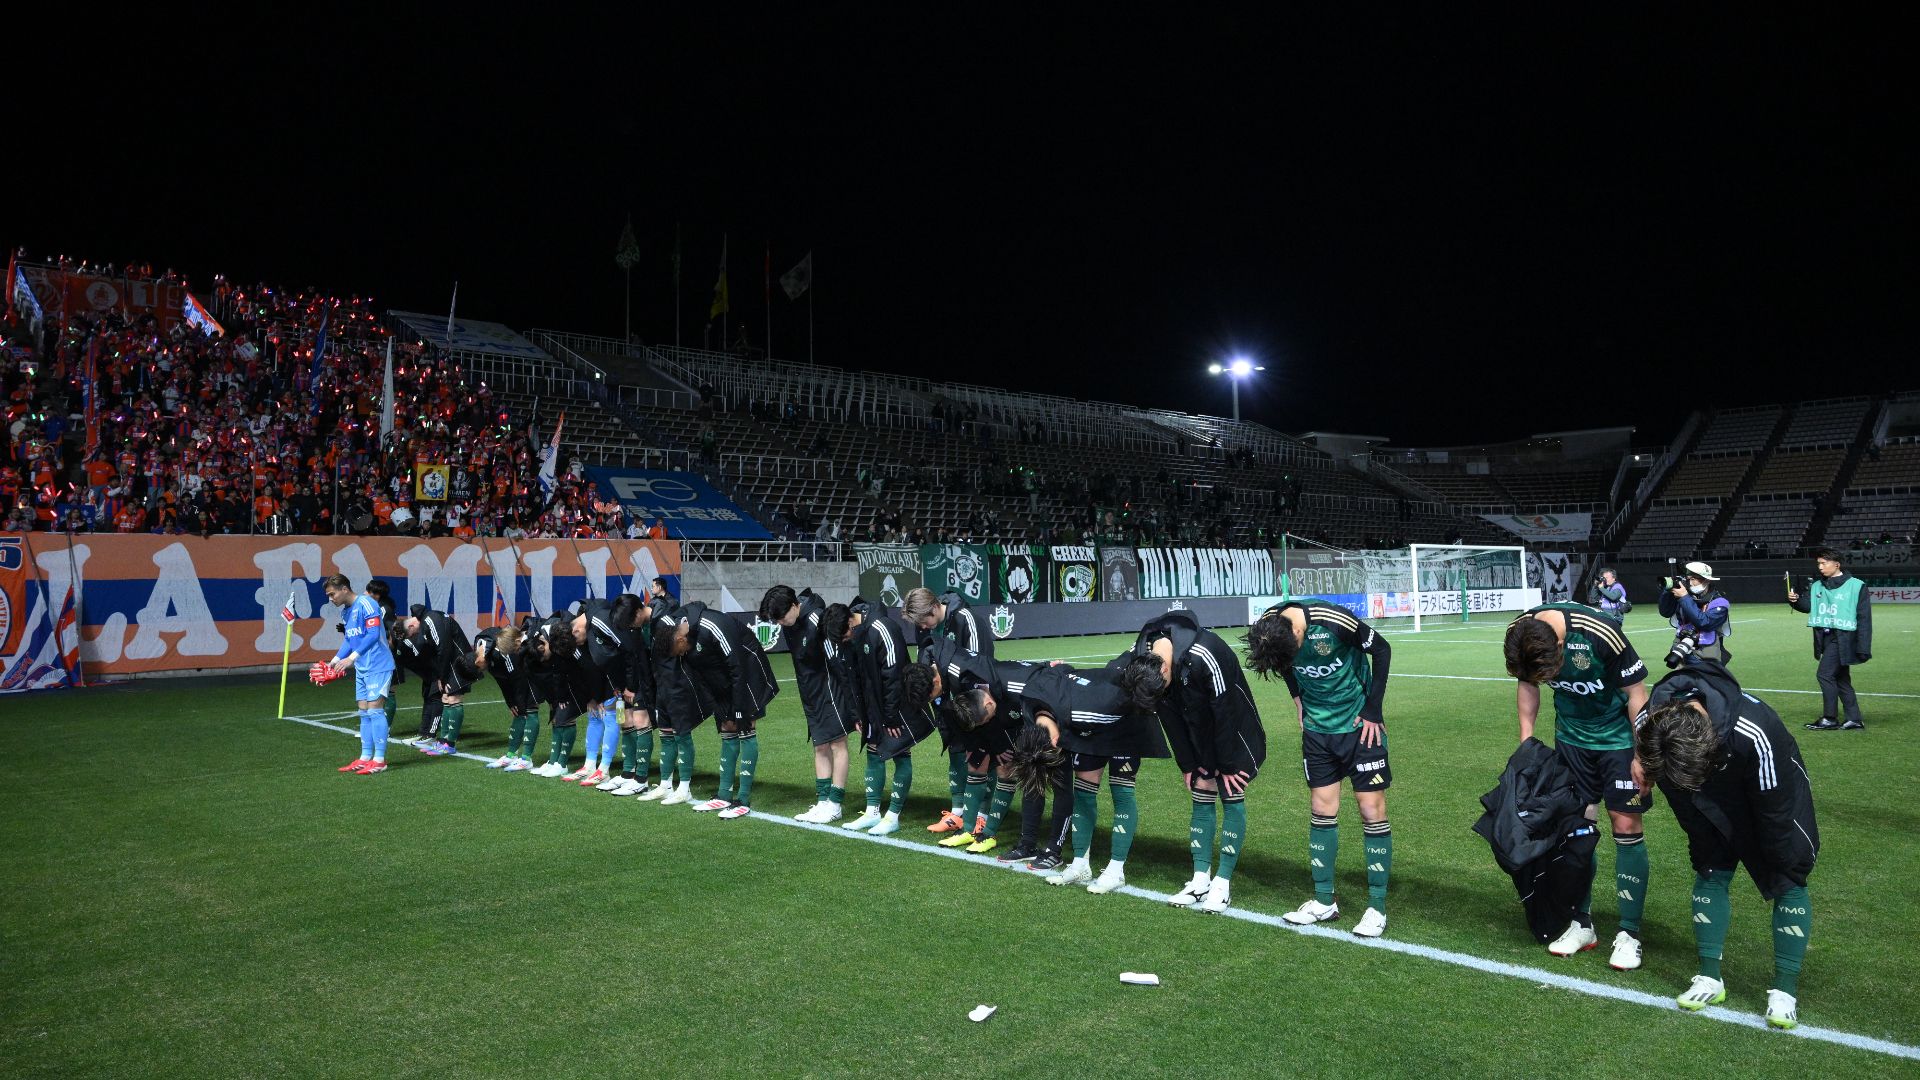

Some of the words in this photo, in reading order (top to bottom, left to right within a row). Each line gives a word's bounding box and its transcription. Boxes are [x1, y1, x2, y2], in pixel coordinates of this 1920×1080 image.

[857, 550, 921, 575] INDOMITABLE
[1138, 548, 1169, 598] TILL
[1195, 548, 1274, 597] MATSUMOTO
[1293, 656, 1344, 679] PSON
[1549, 679, 1604, 696] PSON
[1366, 846, 1387, 855] YMG
[1778, 905, 1806, 915] YMG
